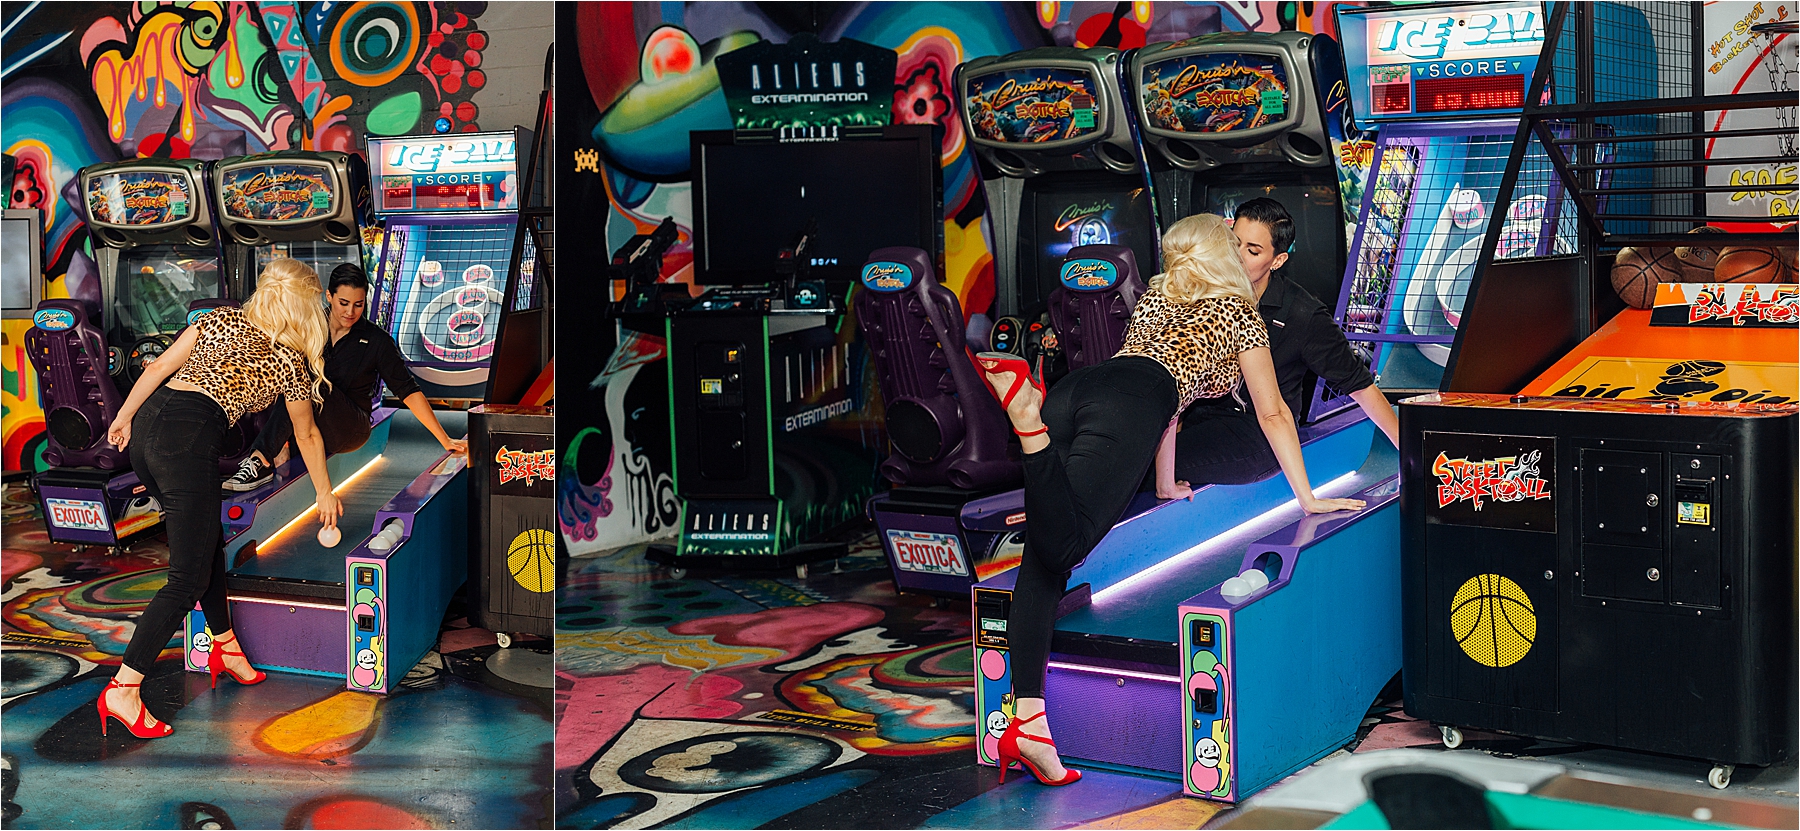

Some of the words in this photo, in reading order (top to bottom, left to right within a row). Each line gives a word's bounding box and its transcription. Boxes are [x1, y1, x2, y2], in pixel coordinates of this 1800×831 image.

[1733, 2, 1765, 36] SHOT
[1378, 17, 1454, 59] ICE
[752, 62, 865, 89] ALIENS
[1170, 60, 1251, 98] Cruis'n
[1374, 73, 1404, 83] LEFT
[1429, 60, 1507, 77] SCORE
[751, 92, 869, 104] EXTERMINATION
[991, 75, 1065, 110] Cruis'n
[1196, 89, 1257, 108] EXOTICA
[1015, 102, 1070, 120] EXOTICA
[390, 144, 445, 172] ICE
[244, 170, 308, 196] Cruis'n
[426, 174, 482, 185] SCORE
[125, 195, 168, 209] EXOTICA
[263, 190, 311, 204] EXOTICA
[1054, 199, 1114, 232] Cruis'n
[785, 398, 853, 433] EXTERMINATION
[496, 445, 554, 468] STREET
[1432, 451, 1517, 486] STREET
[53, 507, 104, 525] EXOTICA
[693, 513, 769, 530] ALIENS
[896, 542, 962, 568] EXOTICA
